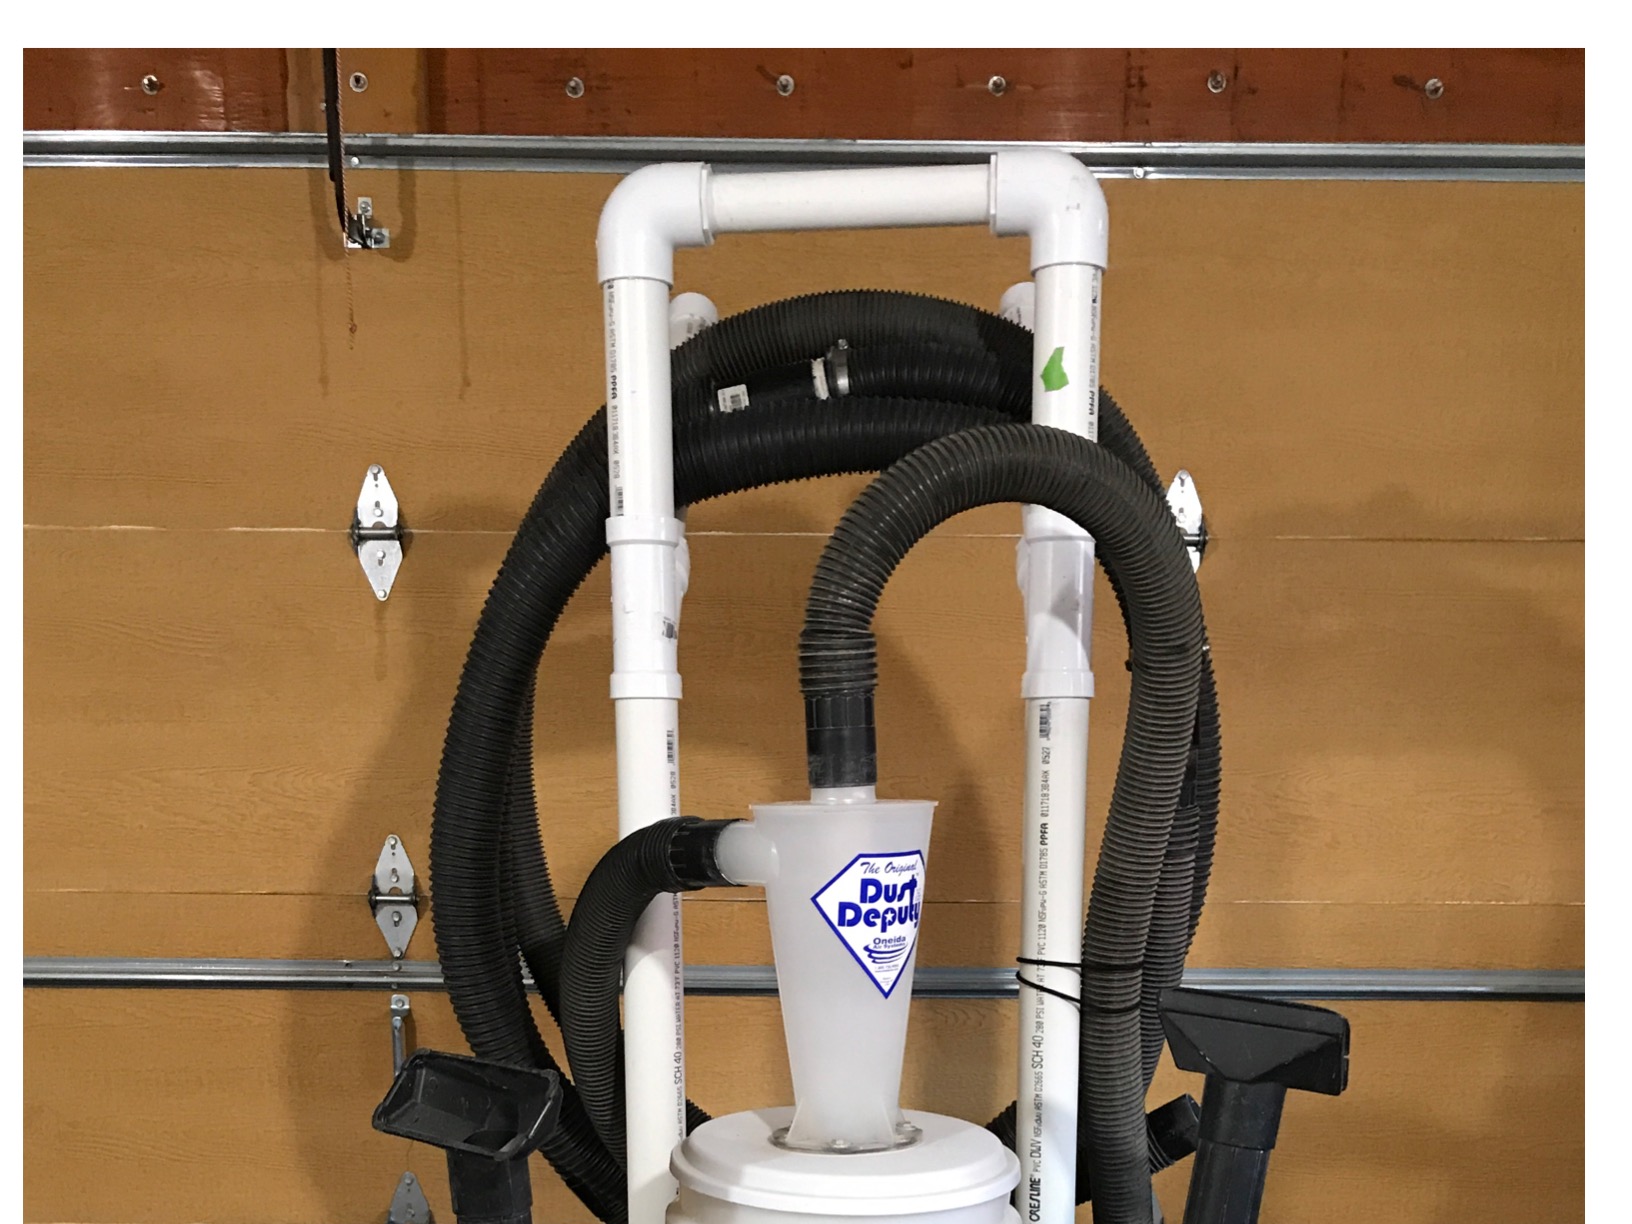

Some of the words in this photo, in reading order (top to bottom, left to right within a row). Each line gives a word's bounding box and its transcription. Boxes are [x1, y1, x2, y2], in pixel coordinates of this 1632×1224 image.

[1039, 822, 1049, 846] PPFA
[860, 861, 880, 875] The
[884, 860, 917, 876] Original
[1039, 870, 1048, 889] ASTM
[859, 874, 918, 904] Dust
[837, 901, 920, 933] Deputy
[872, 935, 907, 945] Oneida
[1038, 923, 1047, 941] 1120
[1037, 942, 1046, 956] PVC
[1036, 974, 1045, 983] AT
[1036, 1007, 1045, 1019] PSI
[1031, 1035, 1044, 1049] 40
[673, 1051, 682, 1065] 40
[1031, 1050, 1044, 1070] SCH
[673, 1066, 683, 1085] SCH
[1034, 1093, 1043, 1111] ASTM
[1030, 1138, 1042, 1159] DWV
[1033, 1159, 1042, 1173] PVC
